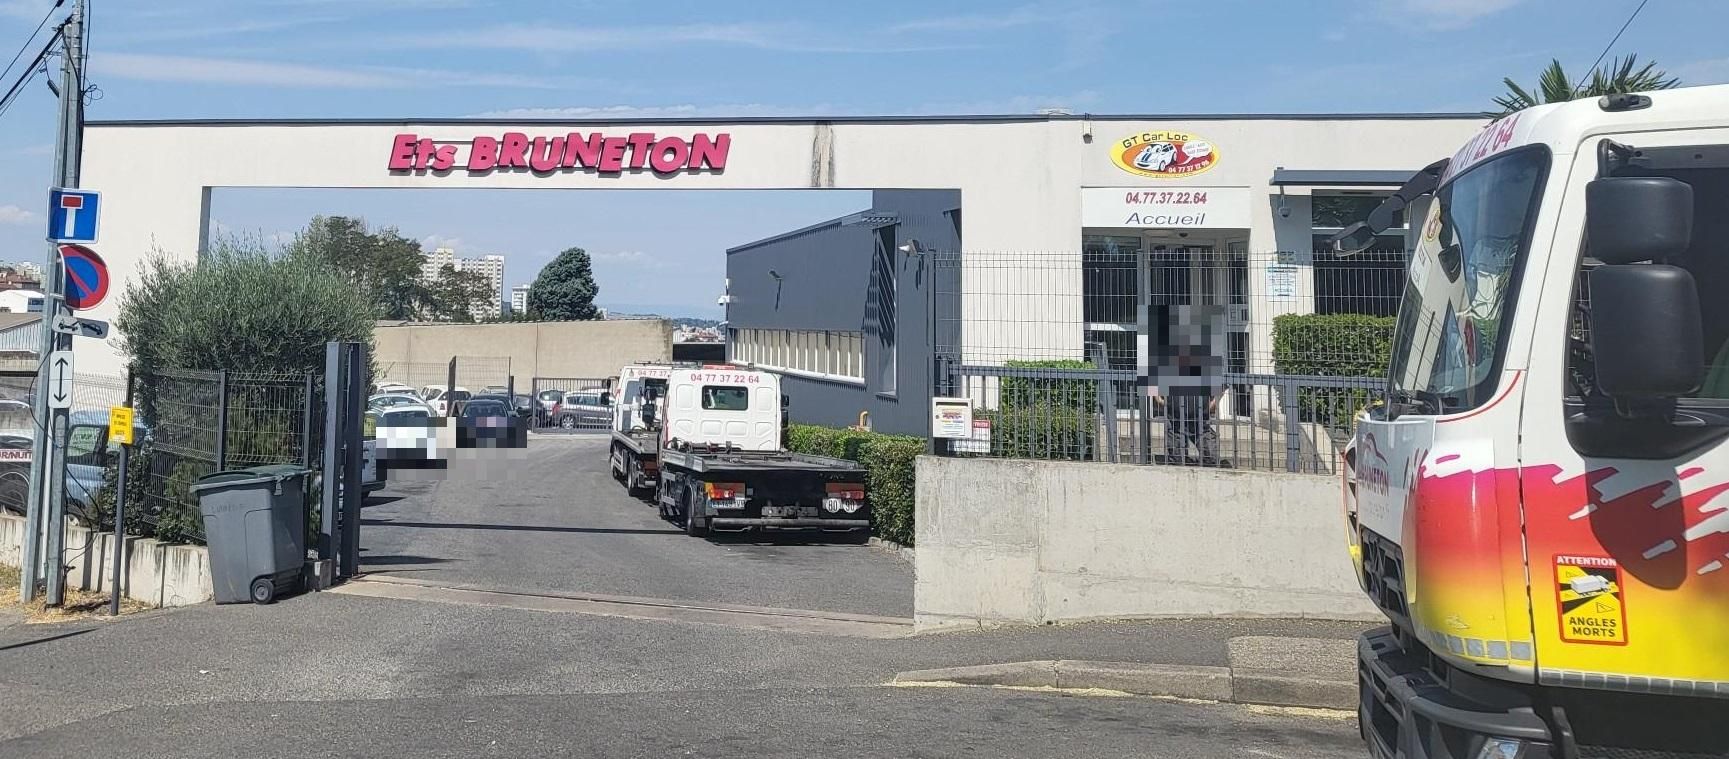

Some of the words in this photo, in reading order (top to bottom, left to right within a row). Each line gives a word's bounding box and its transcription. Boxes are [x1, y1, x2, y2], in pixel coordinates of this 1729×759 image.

[1491, 112, 1521, 152] 64
[1122, 136, 1138, 149] GT
[1142, 132, 1163, 142] Car
[1167, 131, 1189, 141] Loc
[388, 133, 458, 171] Ets
[467, 131, 731, 174] BRUNETON
[1125, 191, 1208, 205] 04.77.37.22.64
[1124, 212, 1206, 226] Accueil
[690, 373, 702, 382] 04
[705, 374, 716, 382] 77
[719, 374, 731, 383] 37
[734, 375, 745, 383] 22
[748, 375, 759, 383] 64
[1556, 555, 1617, 567] ATTENTION
[1569, 616, 1617, 628] ANGLES
[1572, 626, 1615, 638] MORTS
